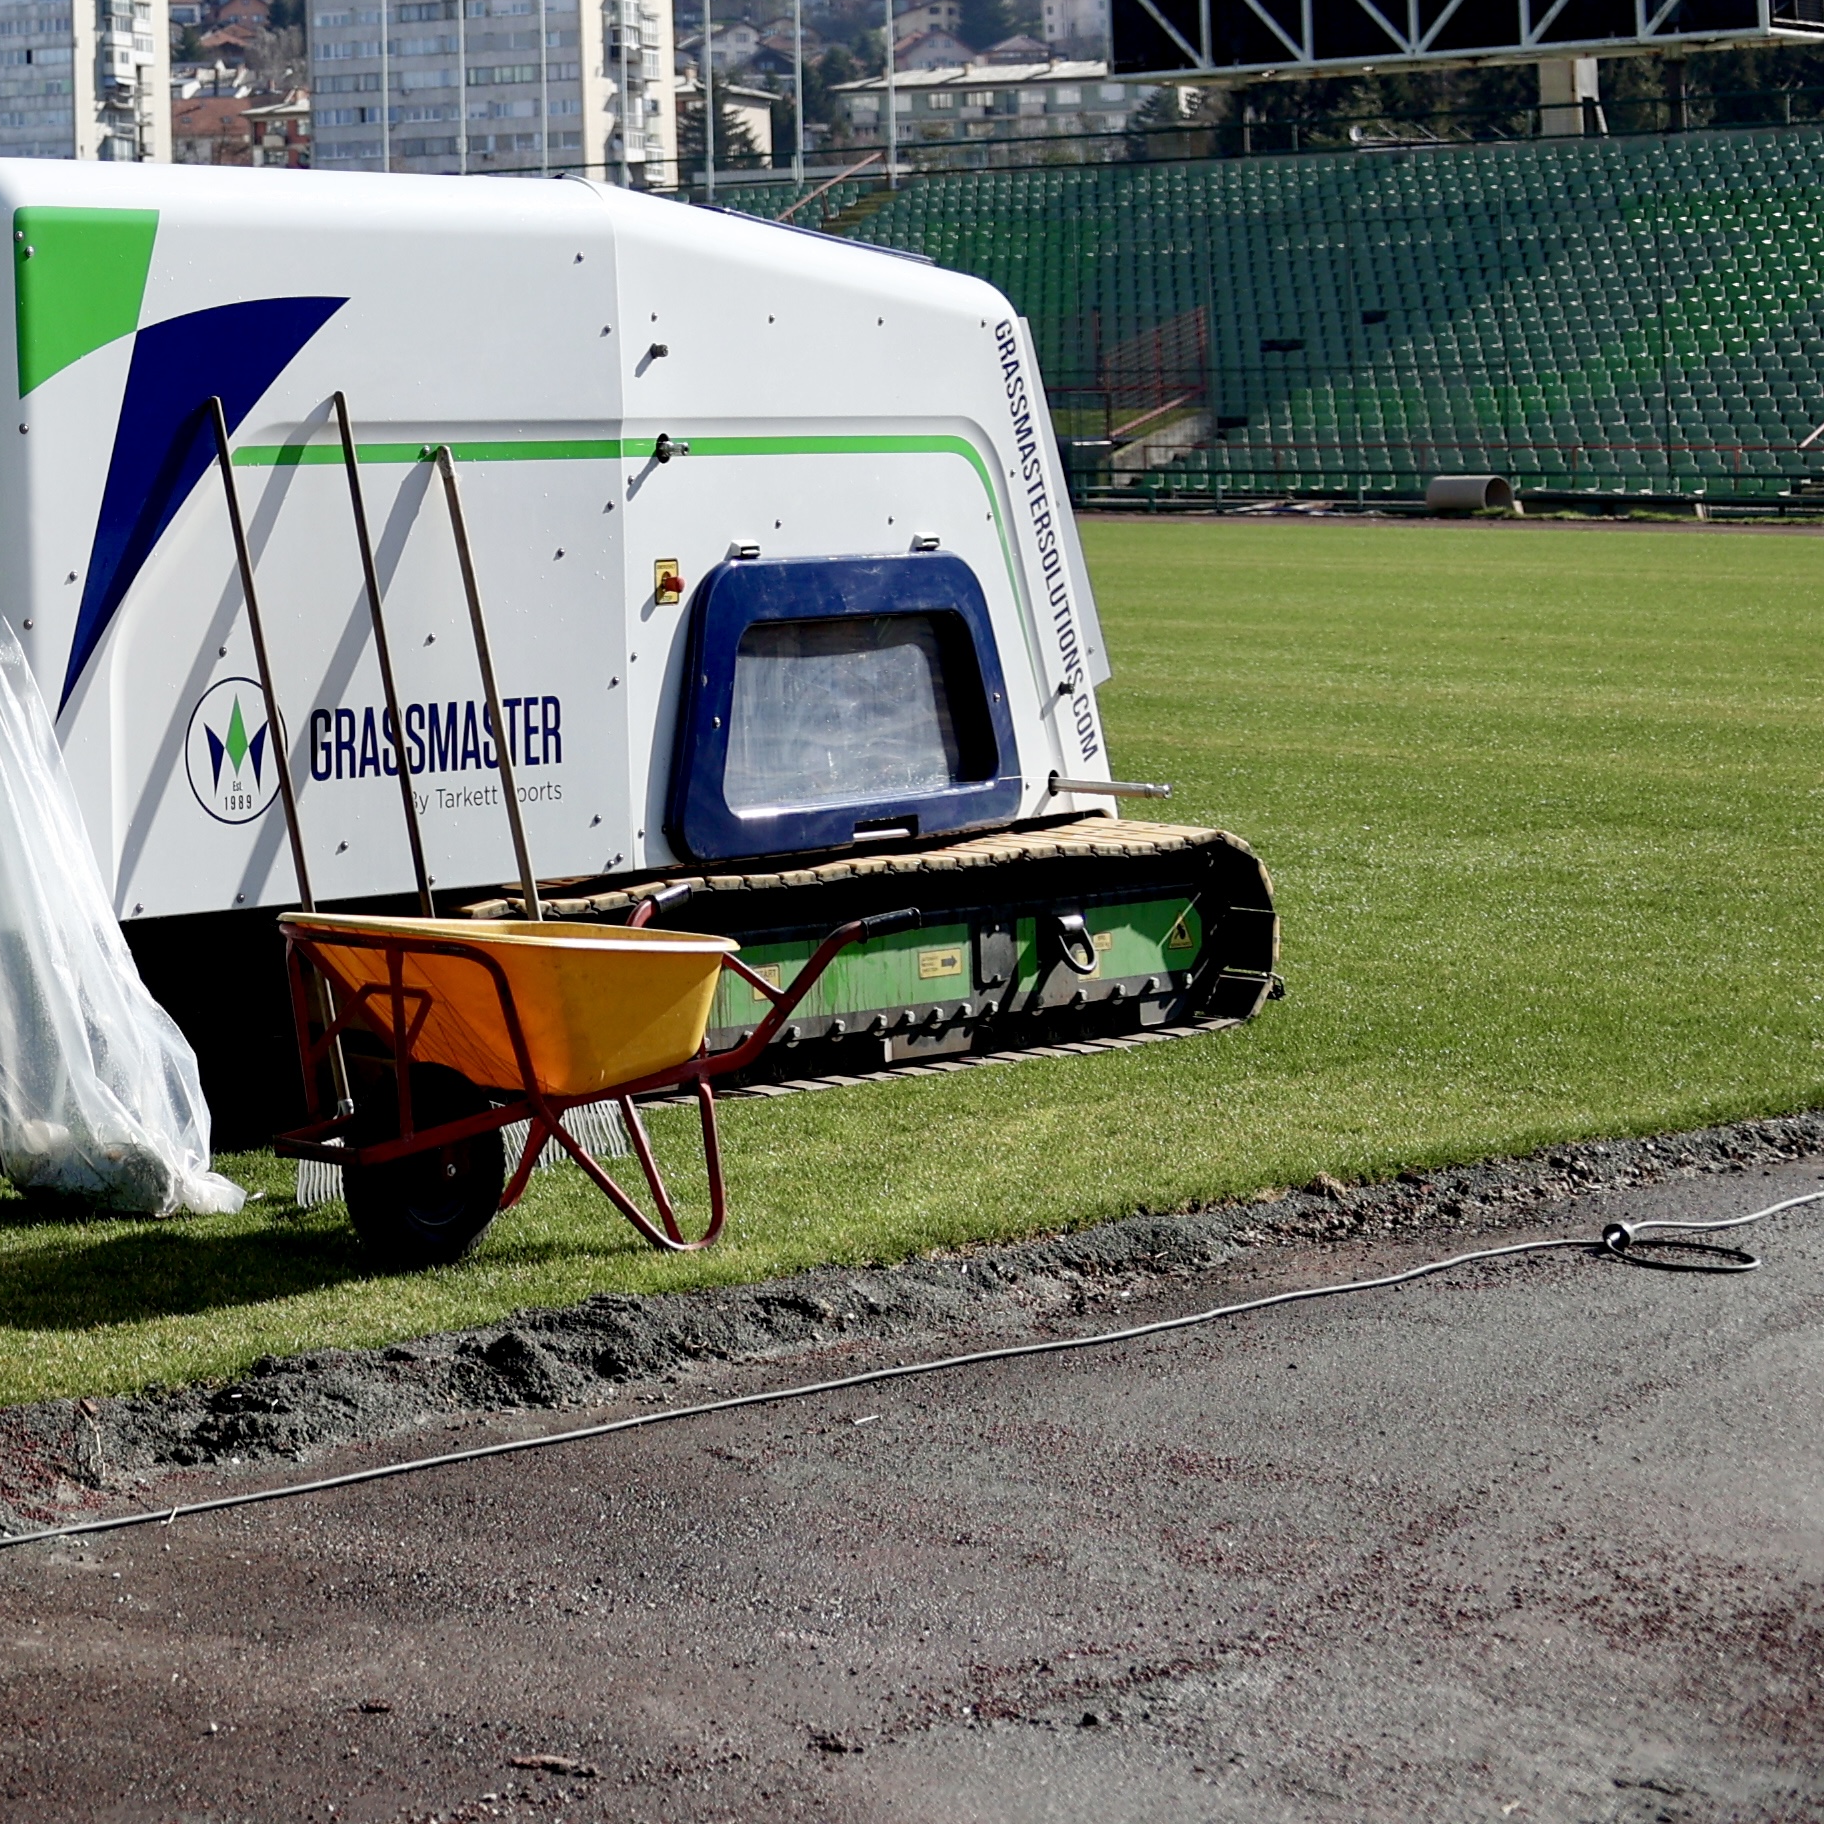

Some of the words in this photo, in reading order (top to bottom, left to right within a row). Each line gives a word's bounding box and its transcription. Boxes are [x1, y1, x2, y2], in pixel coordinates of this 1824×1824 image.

[310, 695, 562, 782] GRASSMASTER
[224, 794, 252, 811] 1989
[435, 784, 499, 810] Tarkett
[516, 780, 563, 803] ports
